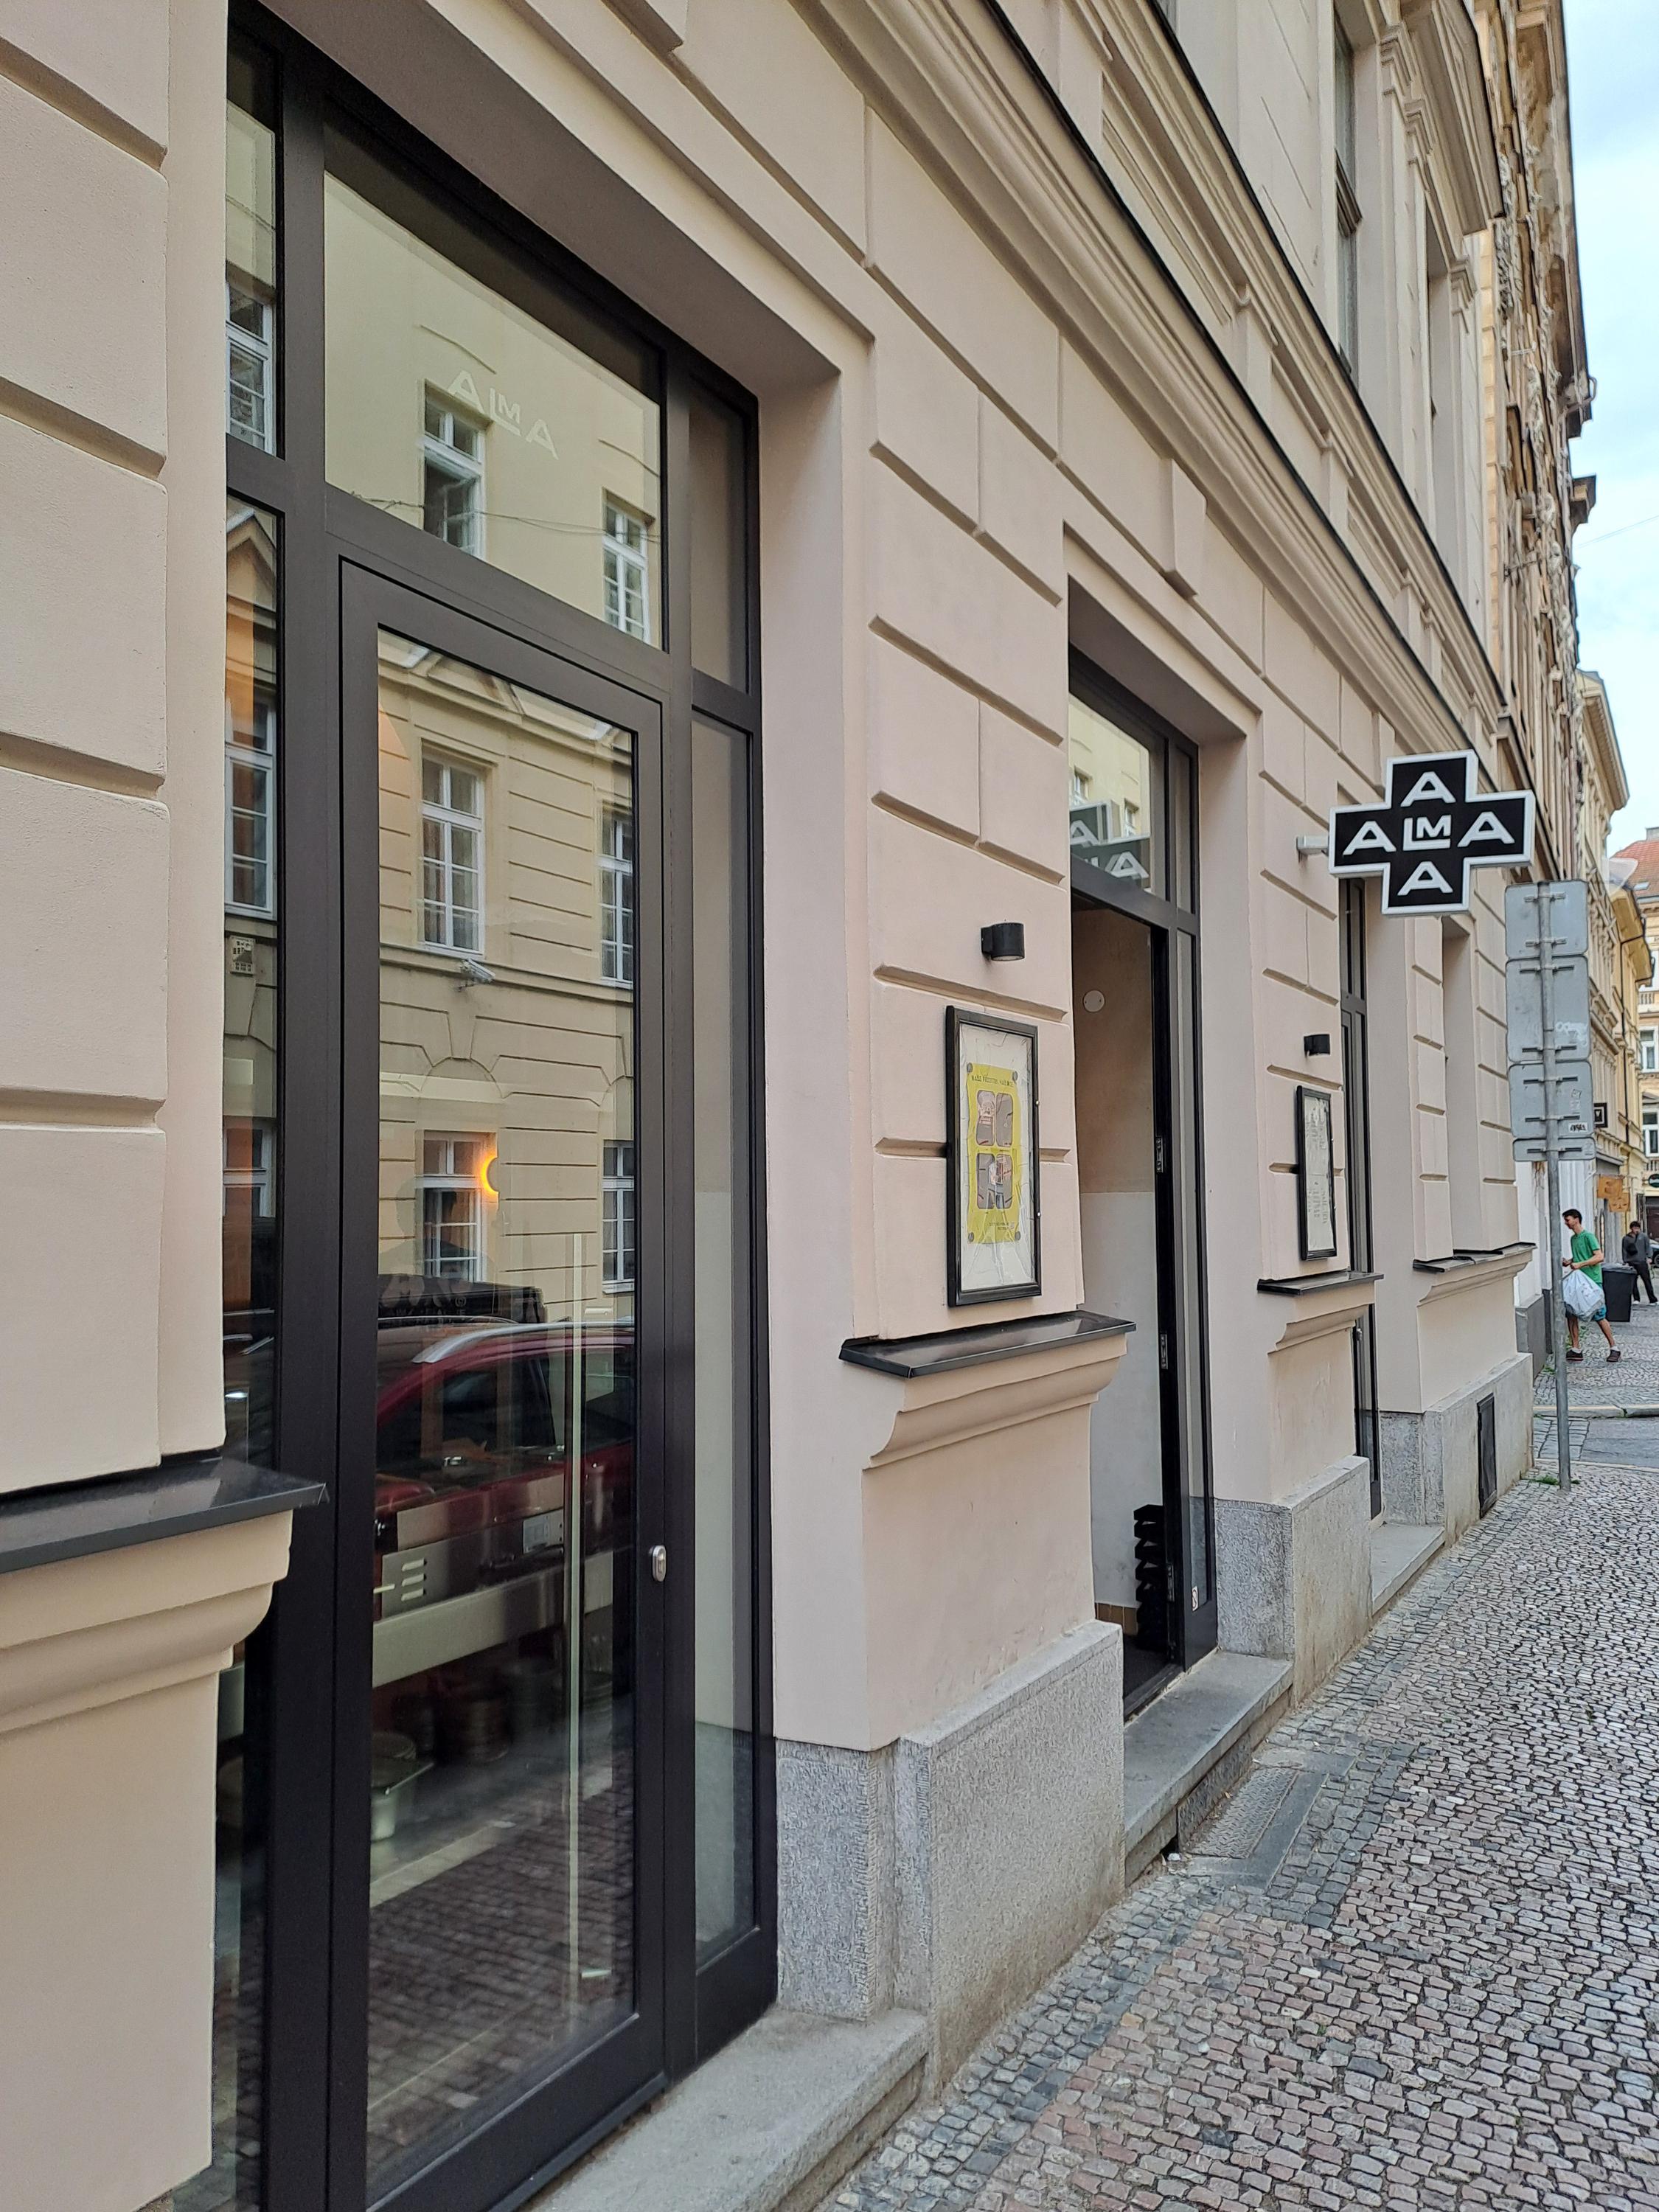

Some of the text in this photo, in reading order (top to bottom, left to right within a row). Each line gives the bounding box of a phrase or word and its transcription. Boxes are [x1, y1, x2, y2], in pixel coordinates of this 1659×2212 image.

[448, 370, 559, 461] ALMA
[1400, 771, 1456, 807] A
[1397, 861, 1453, 896] A
